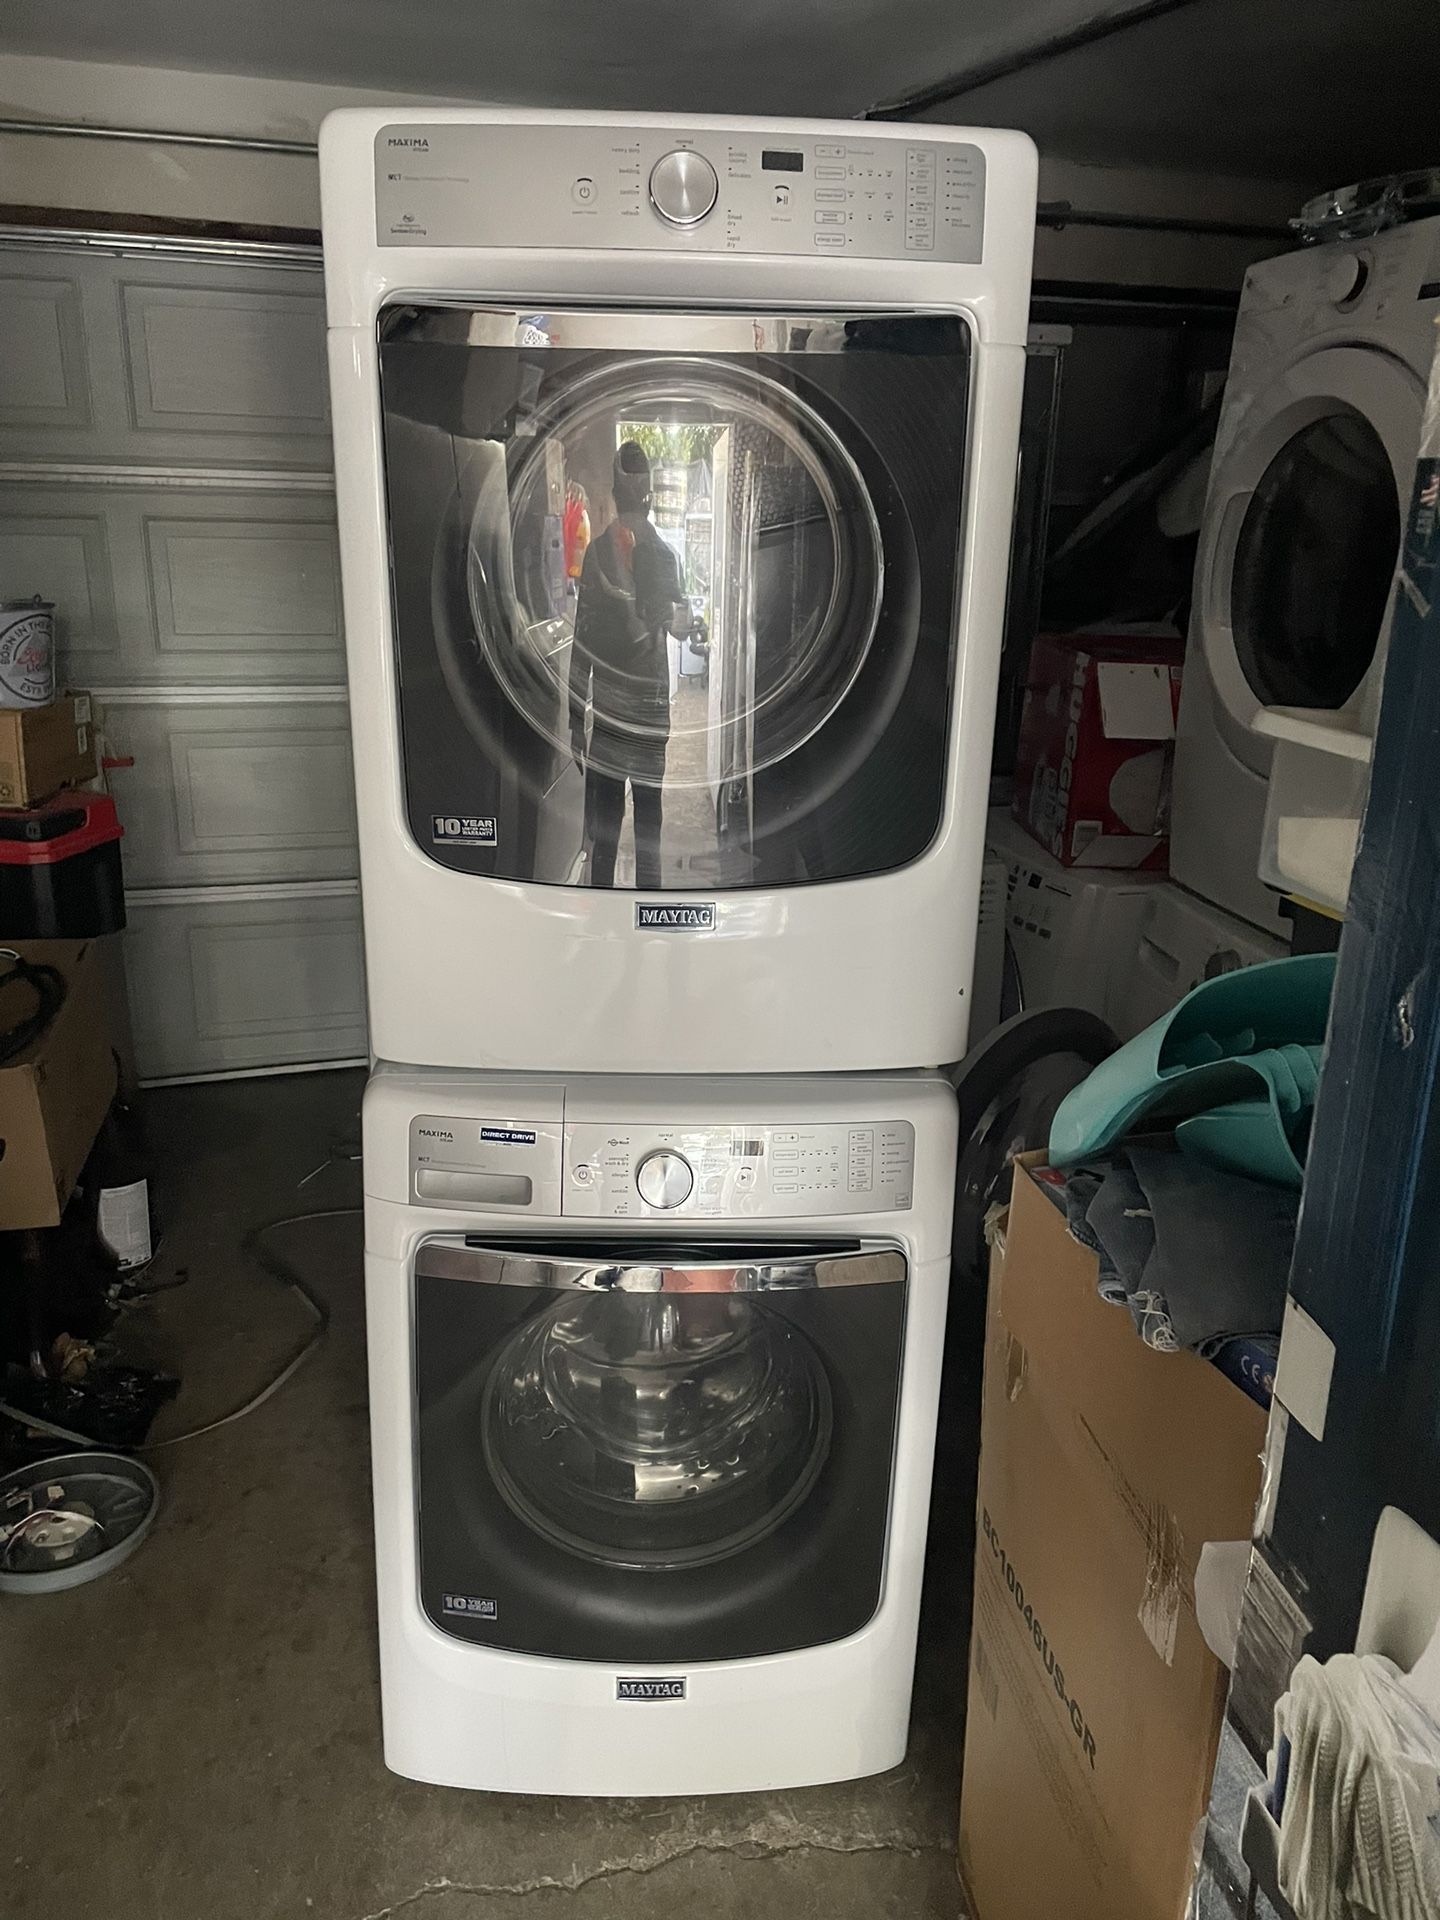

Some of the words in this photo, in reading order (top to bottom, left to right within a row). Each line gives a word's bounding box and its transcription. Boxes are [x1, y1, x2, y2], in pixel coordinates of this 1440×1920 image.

[388, 138, 429, 147] MAXIMA
[0, 636, 17, 665] BORN
[14, 625, 28, 638] IN
[435, 818, 461, 835] 10
[462, 819, 493, 828] YEAR
[641, 909, 711, 924] MAYTAG
[418, 1129, 453, 1138] MAXIMA
[482, 1131, 510, 1139] DIRECT
[511, 1133, 535, 1141] DRIVE
[445, 1596, 467, 1609] 10
[622, 1683, 682, 1696] MAYTAG
